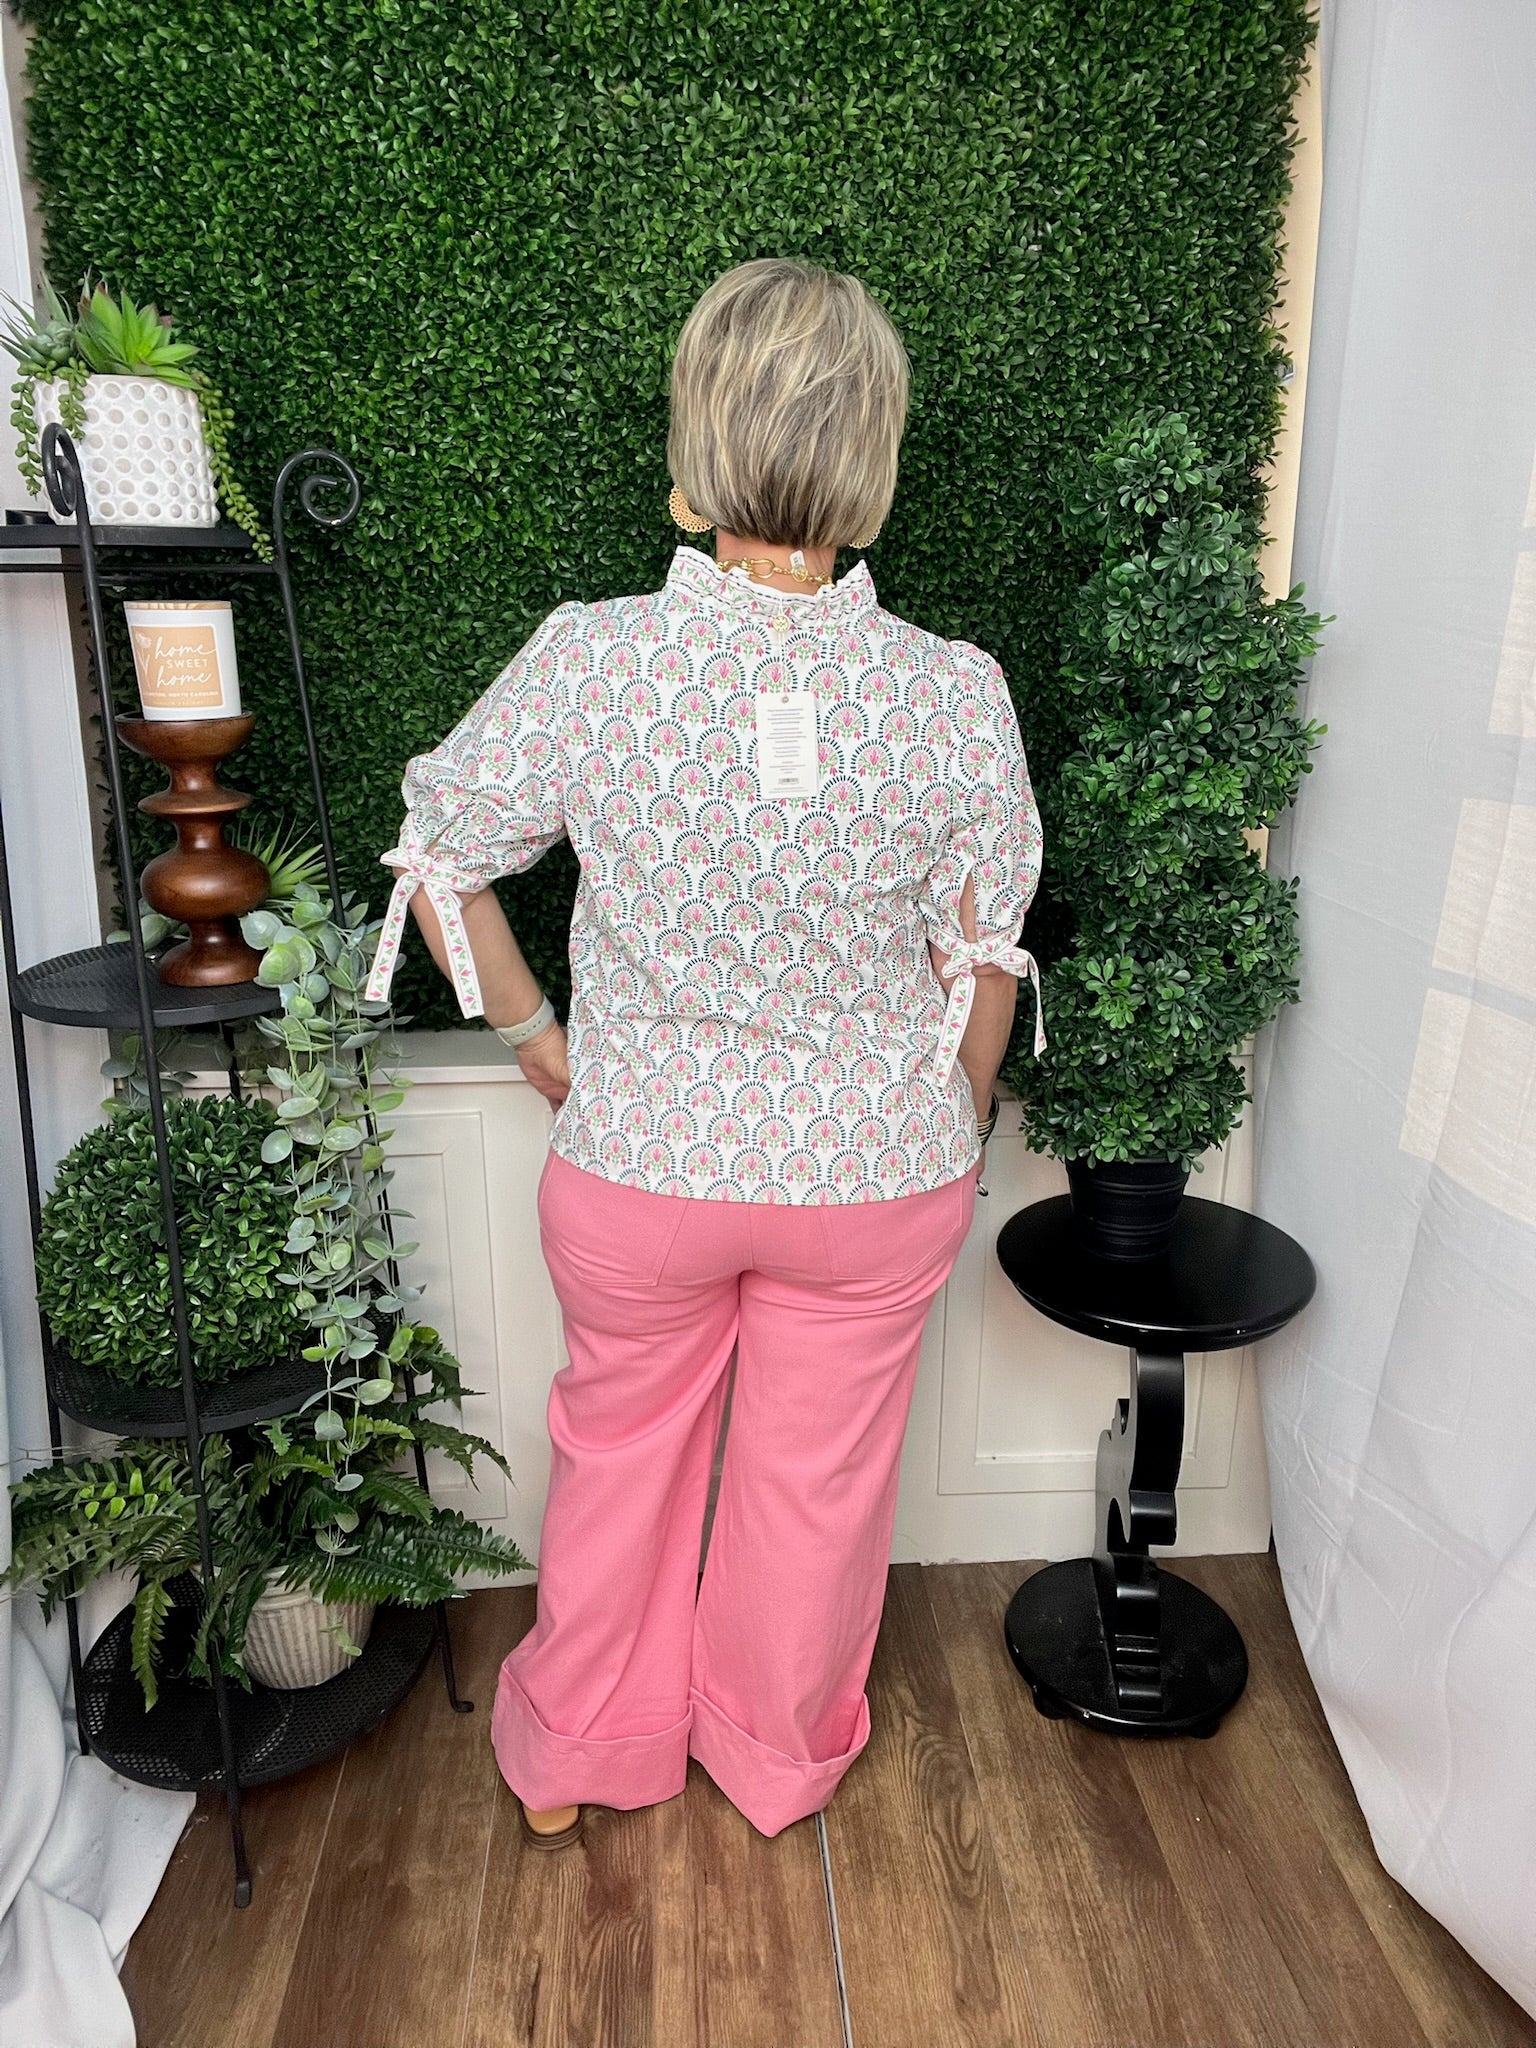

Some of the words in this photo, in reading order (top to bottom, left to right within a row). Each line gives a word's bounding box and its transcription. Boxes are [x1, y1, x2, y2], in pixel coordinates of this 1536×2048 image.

[155, 636, 217, 659] home
[166, 658, 208, 669] SWEET
[157, 666, 212, 688] home
